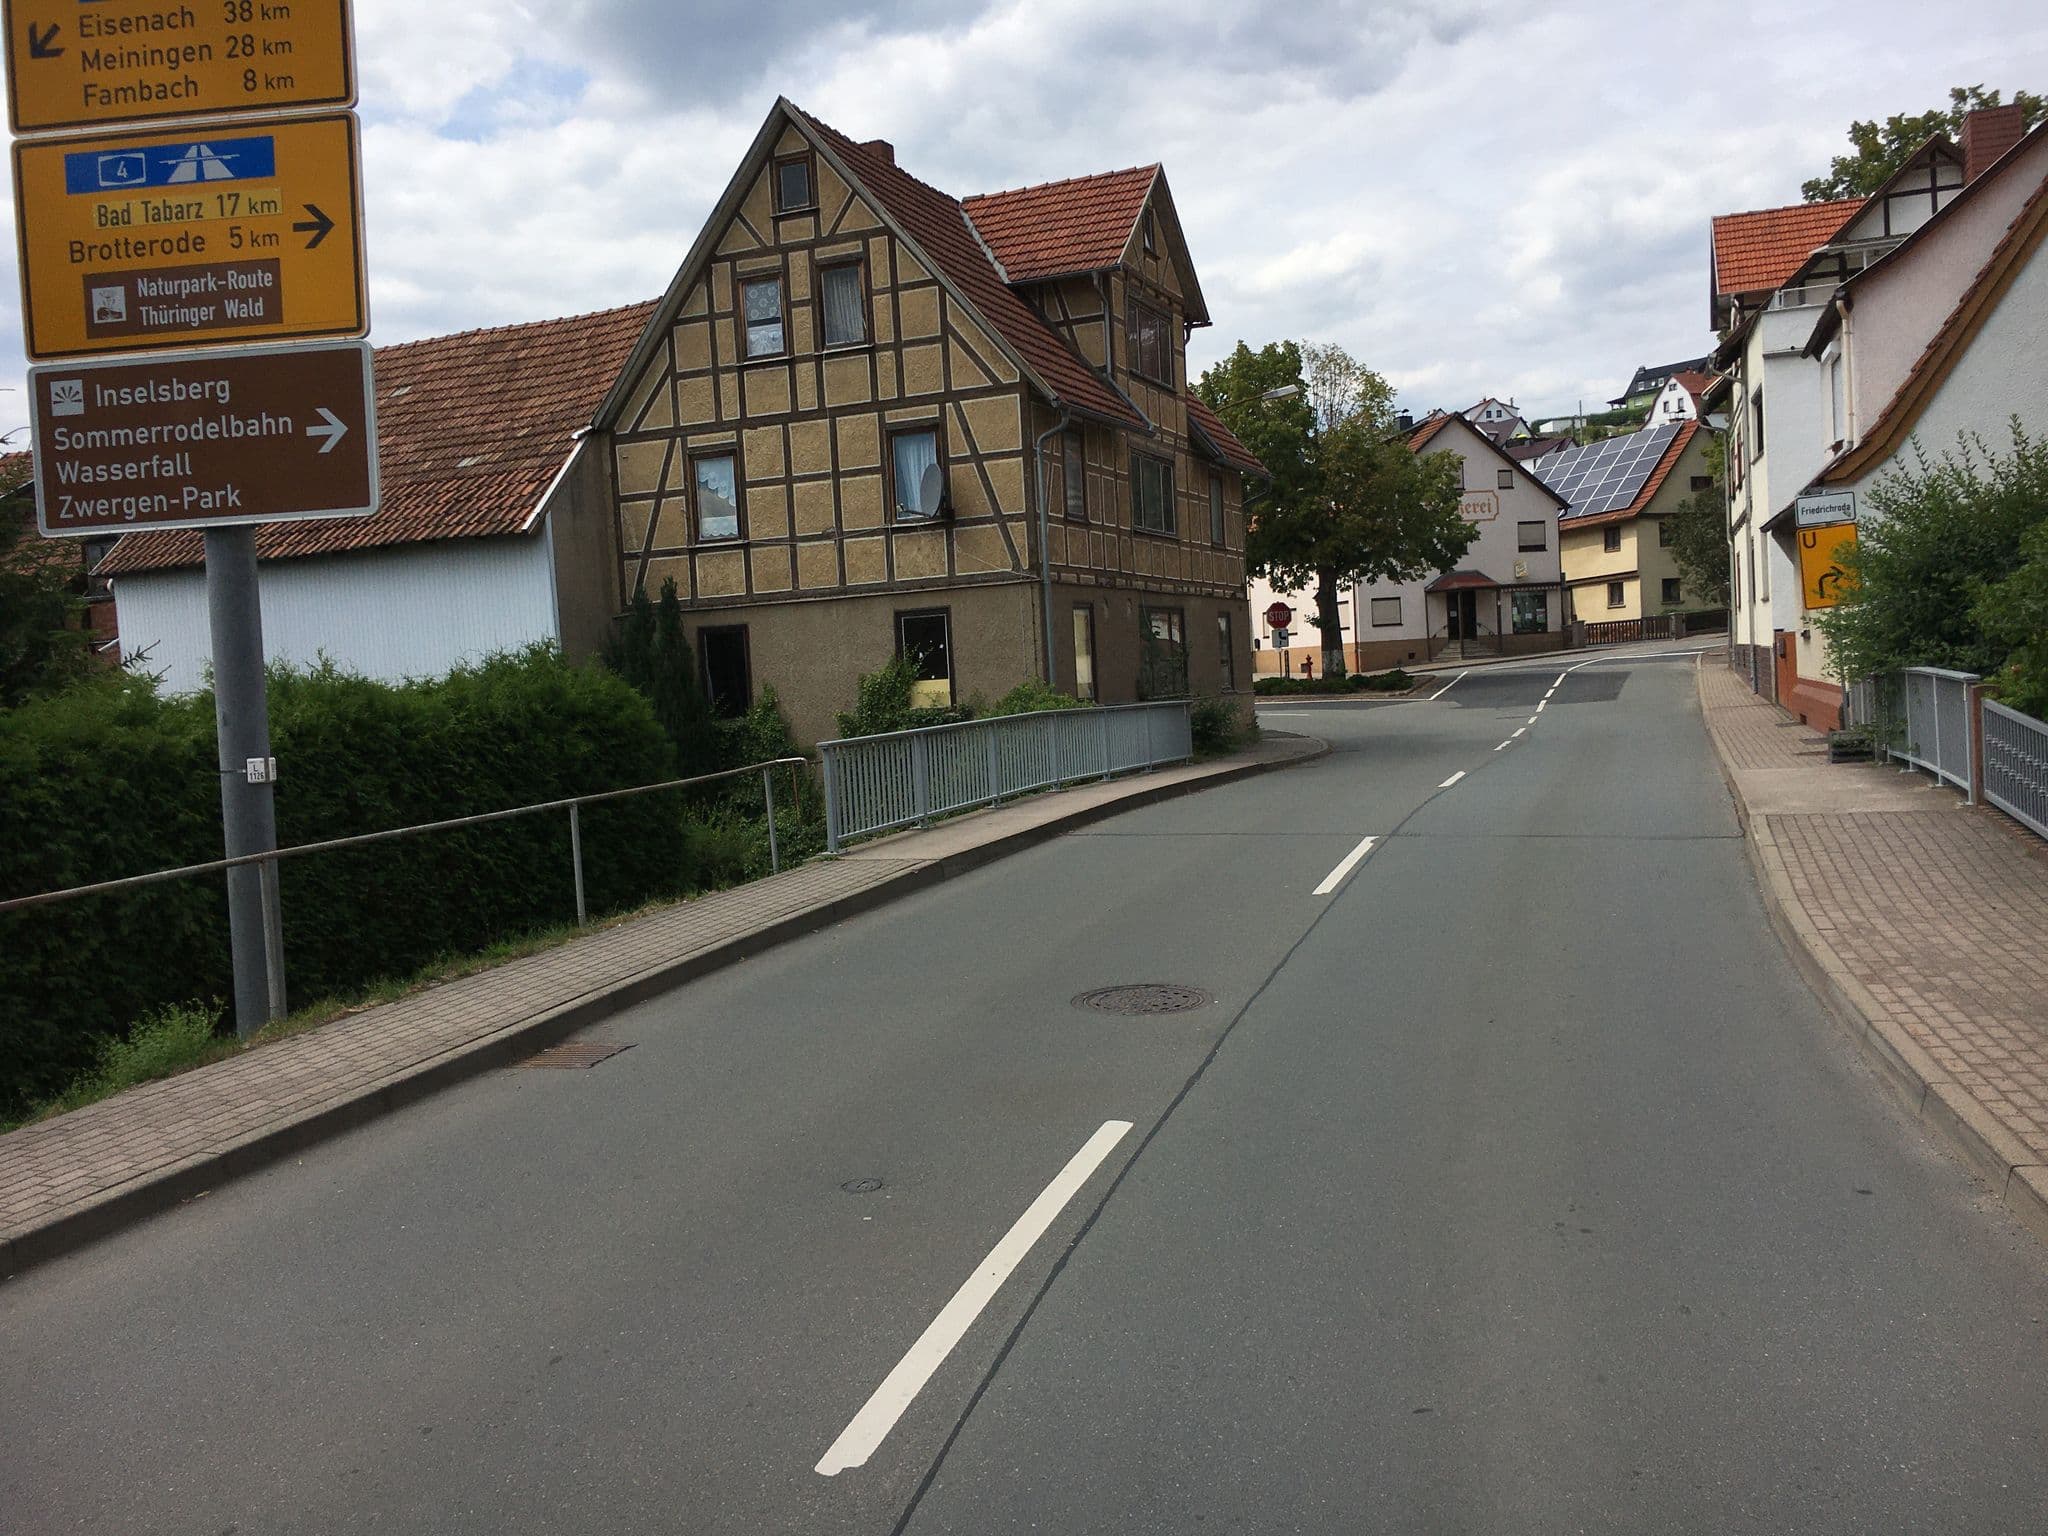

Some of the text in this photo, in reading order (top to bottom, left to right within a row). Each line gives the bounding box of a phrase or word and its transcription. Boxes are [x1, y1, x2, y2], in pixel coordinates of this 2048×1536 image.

[80, 0, 291, 38] Eisenach 38 km
[81, 33, 292, 73] Meiningen 28 km
[83, 69, 295, 107] Fambach 8 km
[117, 161, 128, 178] 4
[97, 193, 278, 227] Bad Tabarz 17 km
[69, 226, 280, 264] Brotterode 5 km
[137, 269, 273, 299] Naturpark-Route
[140, 297, 263, 327] Thüringer Wald
[96, 378, 231, 407] Inselsberg
[54, 412, 293, 451] Sommerrodelbahn
[56, 453, 193, 485] Wasserfall
[58, 484, 242, 520] Zwergen-Park
[1801, 502, 1851, 516] Friedrichroda
[1802, 531, 1817, 549] U
[1269, 611, 1289, 621] STOP
